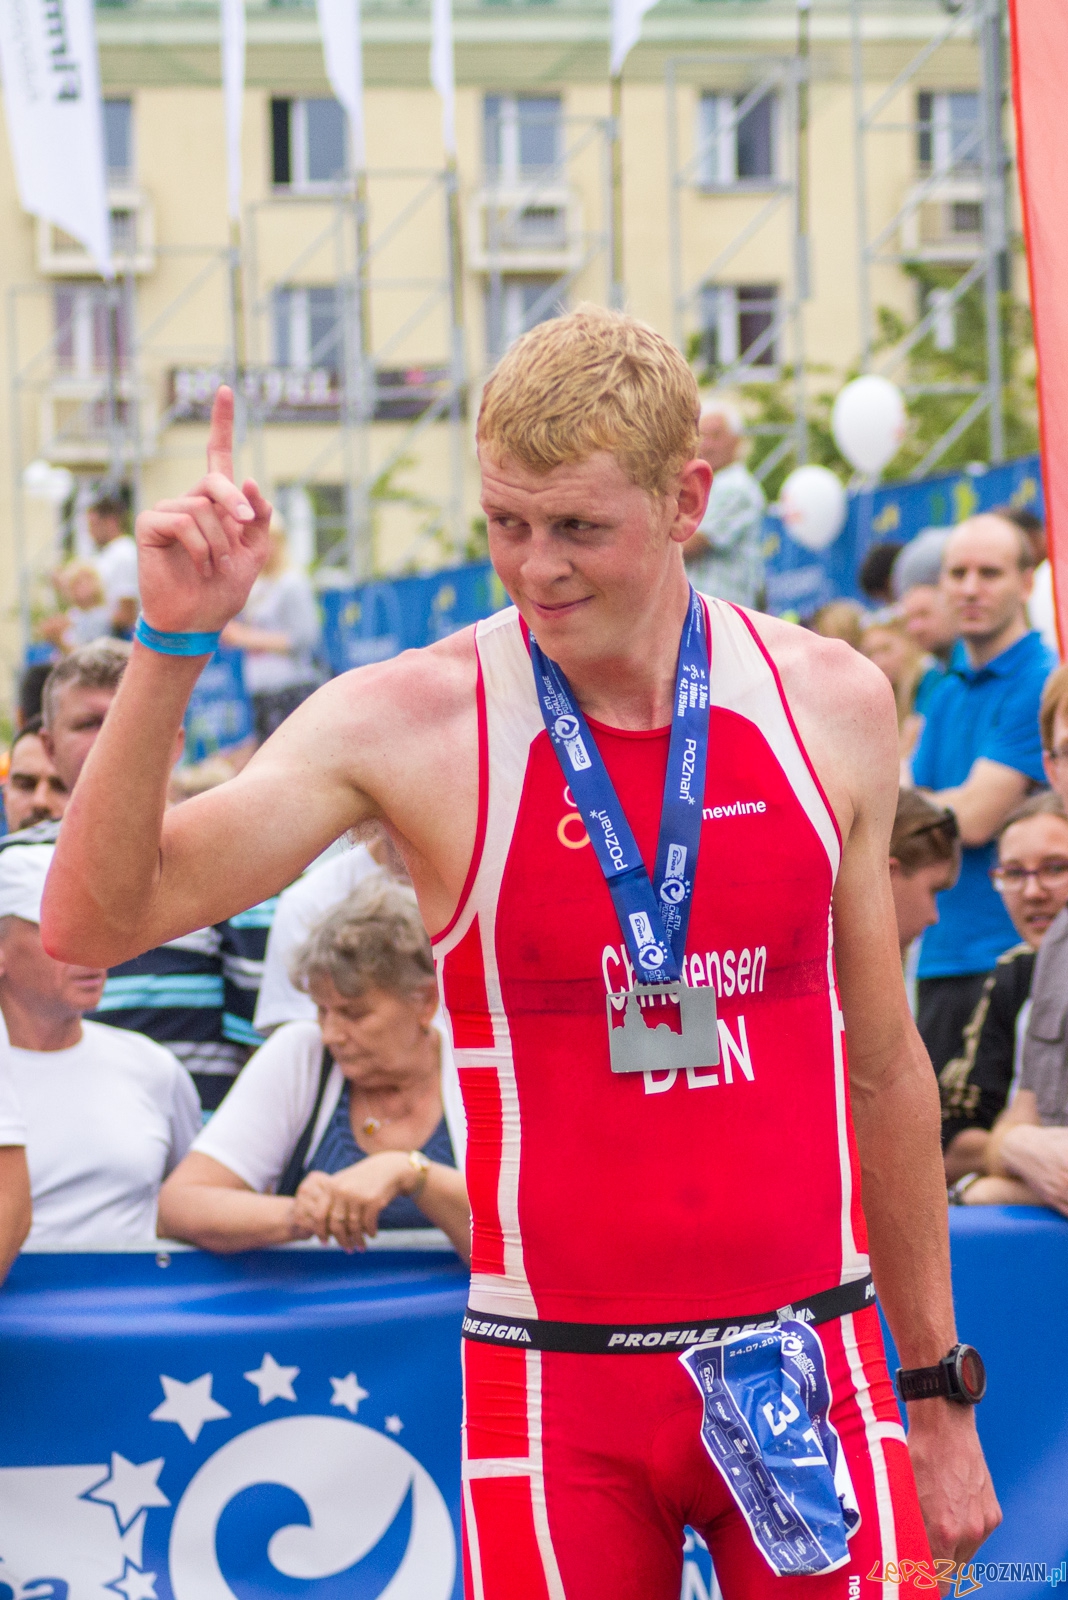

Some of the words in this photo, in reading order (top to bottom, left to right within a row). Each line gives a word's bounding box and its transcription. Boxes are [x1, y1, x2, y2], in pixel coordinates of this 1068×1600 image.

[677, 677, 689, 717] 42,195km
[689, 682, 698, 708] 180km
[699, 683, 708, 709] 3,8km
[702, 801, 767, 820] newline
[608, 1327, 720, 1347] PROFILE
[729, 1335, 781, 1358] 24.07.201
[762, 1392, 829, 1467] 37
